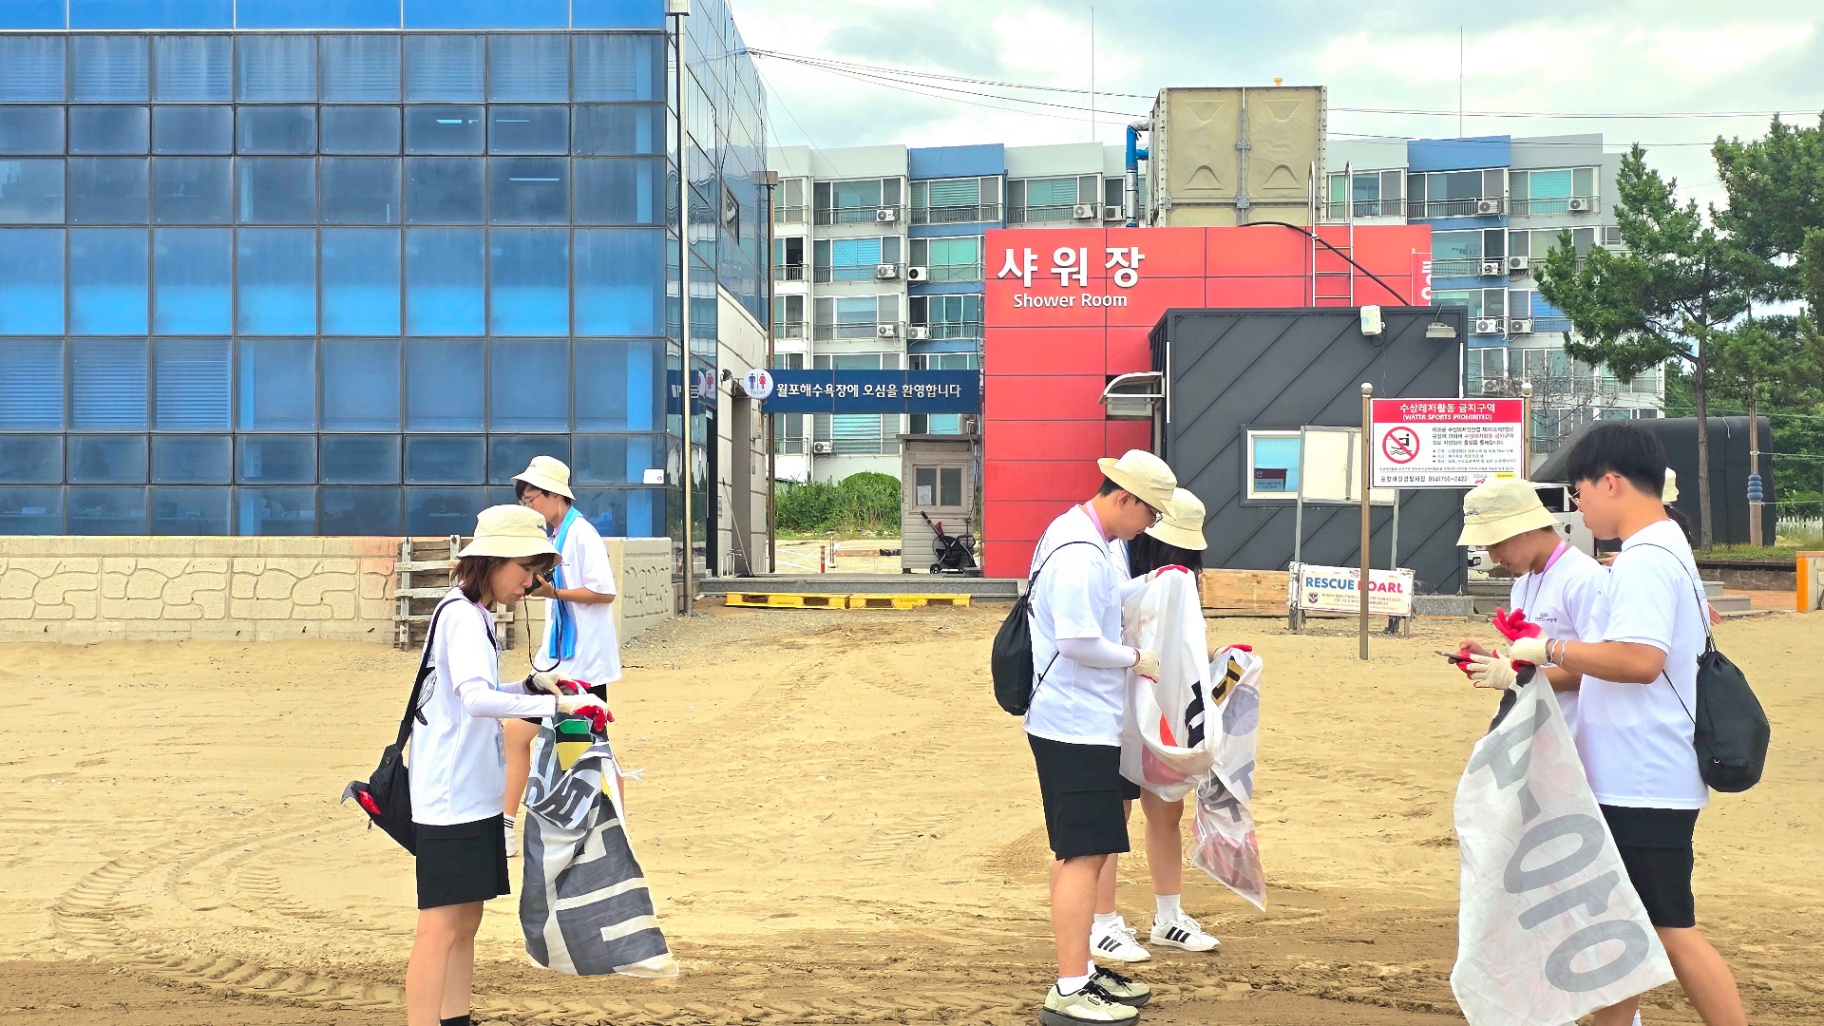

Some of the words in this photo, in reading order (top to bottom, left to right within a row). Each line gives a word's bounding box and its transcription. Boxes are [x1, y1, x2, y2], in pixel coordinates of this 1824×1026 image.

[1013, 293, 1076, 308] Shower
[1081, 293, 1128, 307] Room
[776, 383, 859, 398] 월포해수욕장에
[862, 384, 898, 398] 오심을
[901, 383, 962, 398] 환영합니다
[1458, 403, 1495, 413] 금지구역
[1305, 577, 1355, 590] RESCUE
